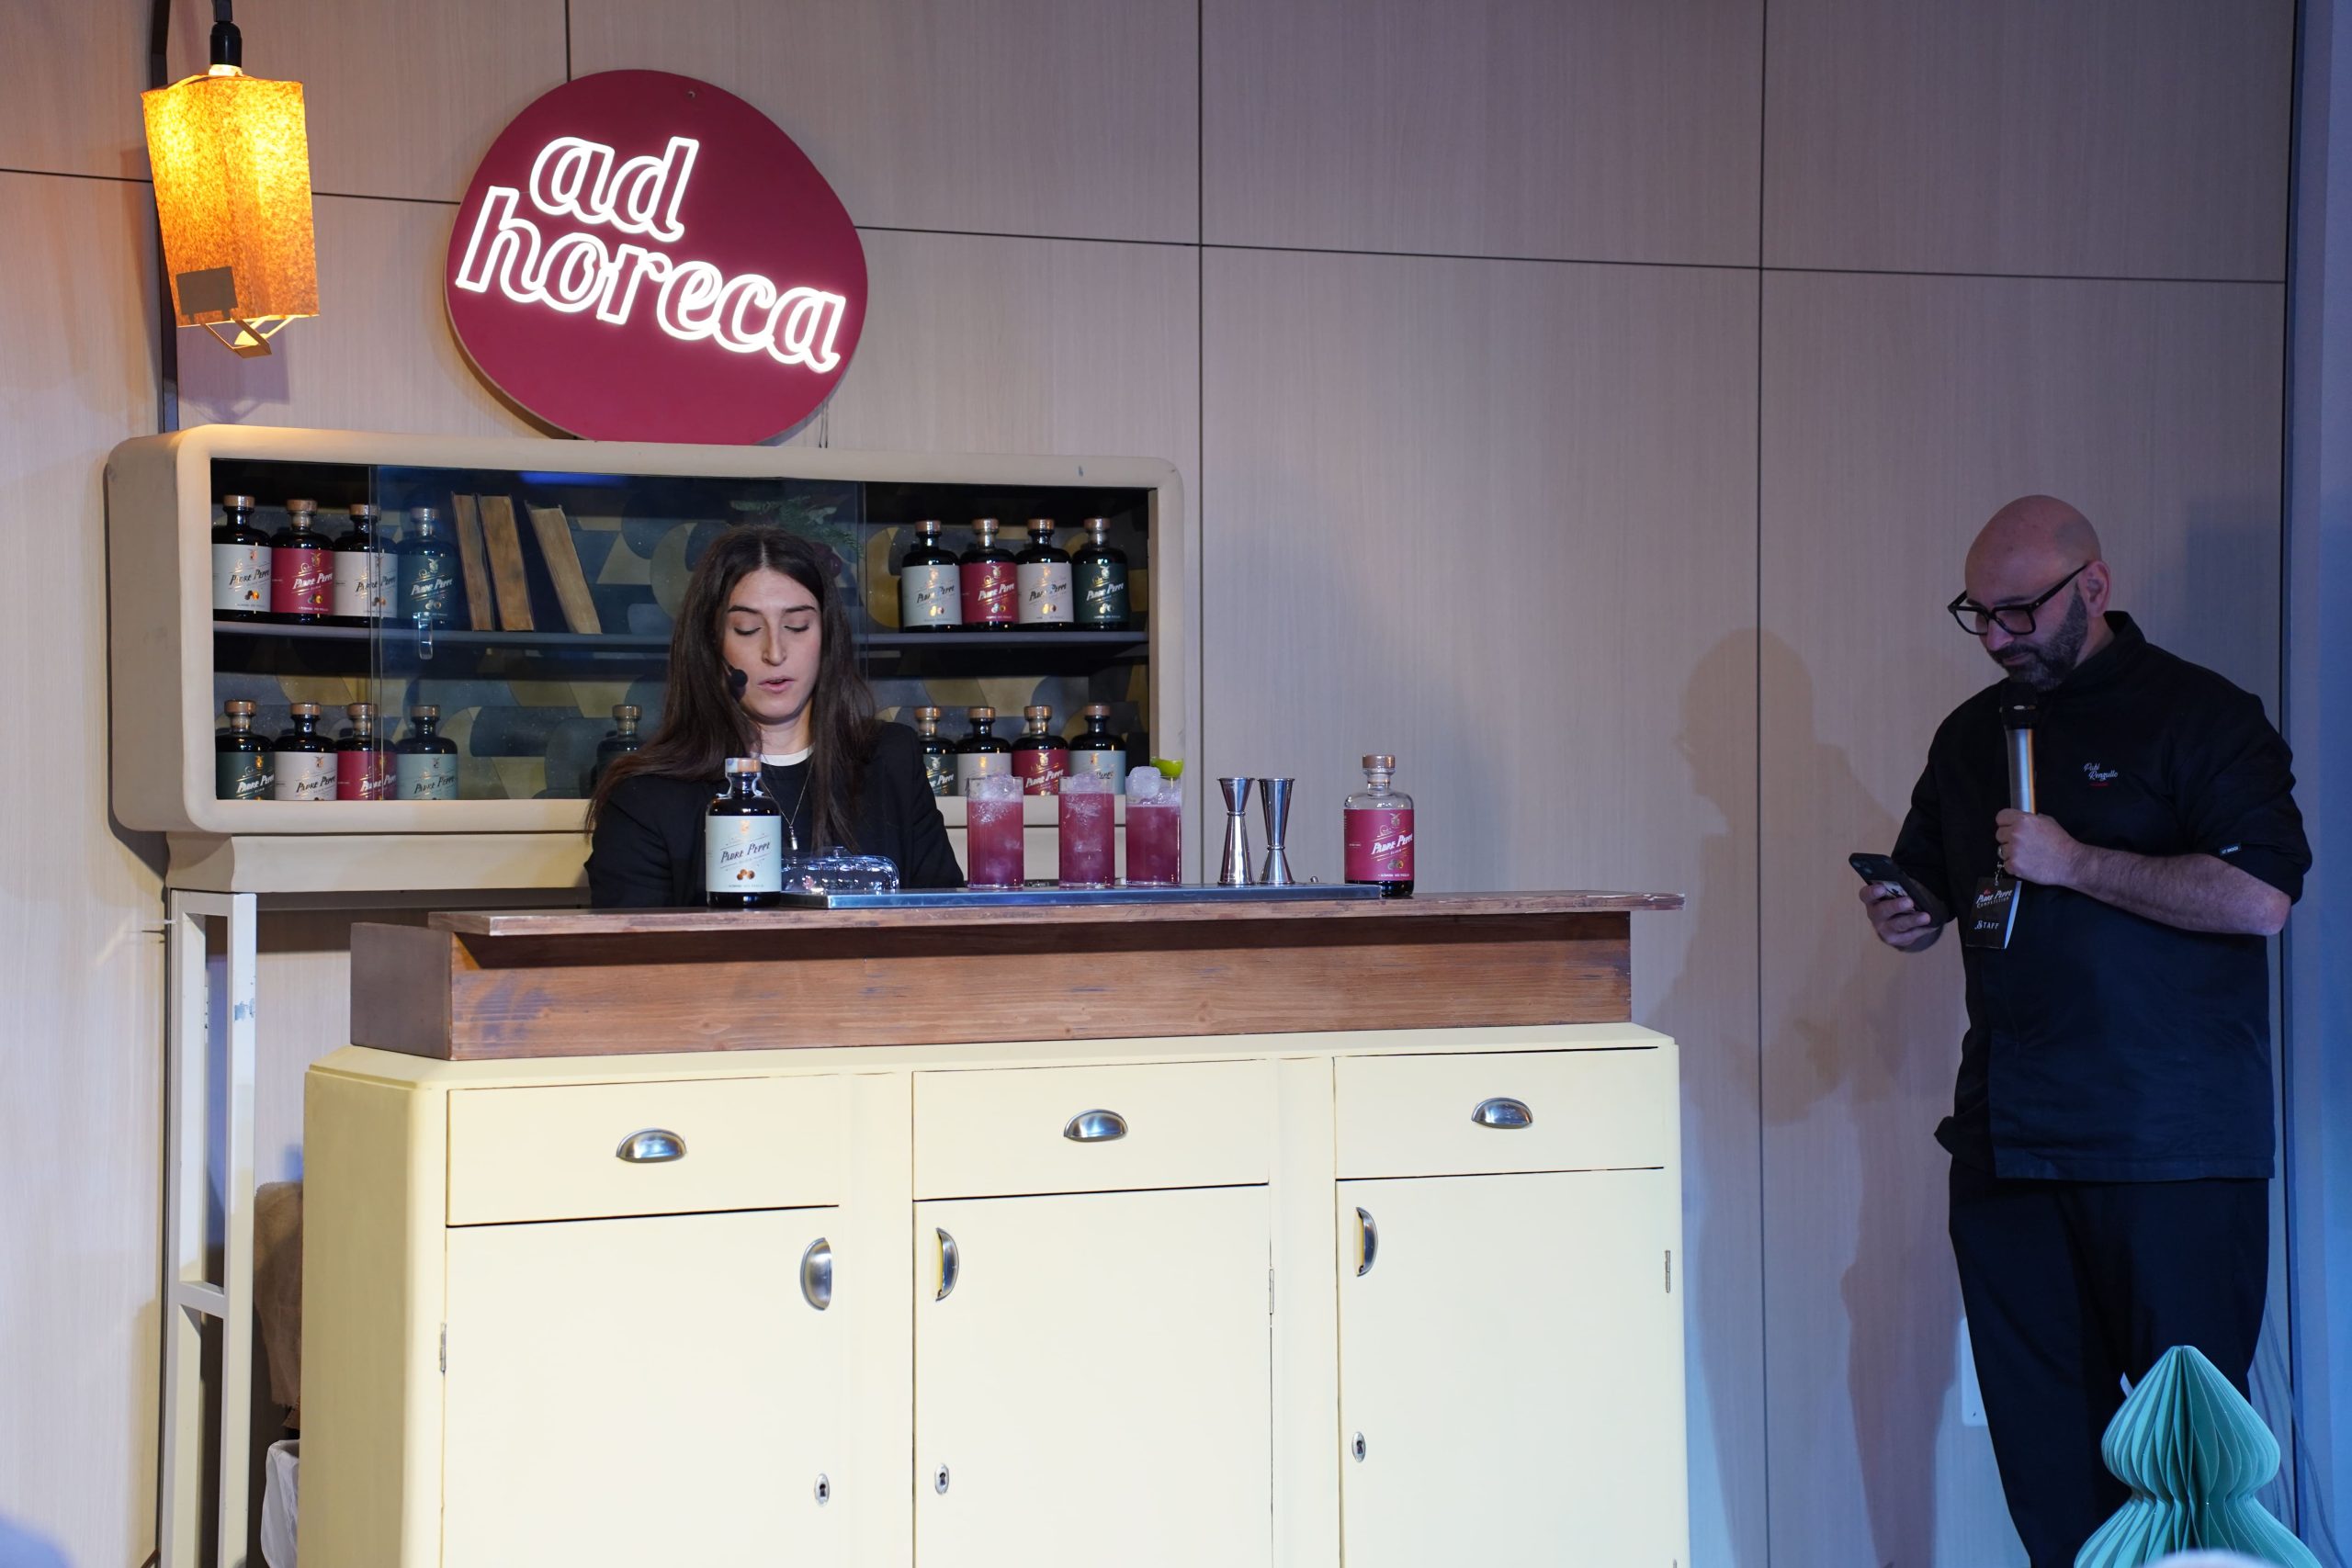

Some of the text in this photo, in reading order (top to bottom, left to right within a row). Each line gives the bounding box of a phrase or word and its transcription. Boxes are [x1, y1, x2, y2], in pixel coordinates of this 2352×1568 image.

[530, 136, 700, 243] ad
[456, 186, 847, 374] horeca
[1973, 919, 2000, 930] STAFF
